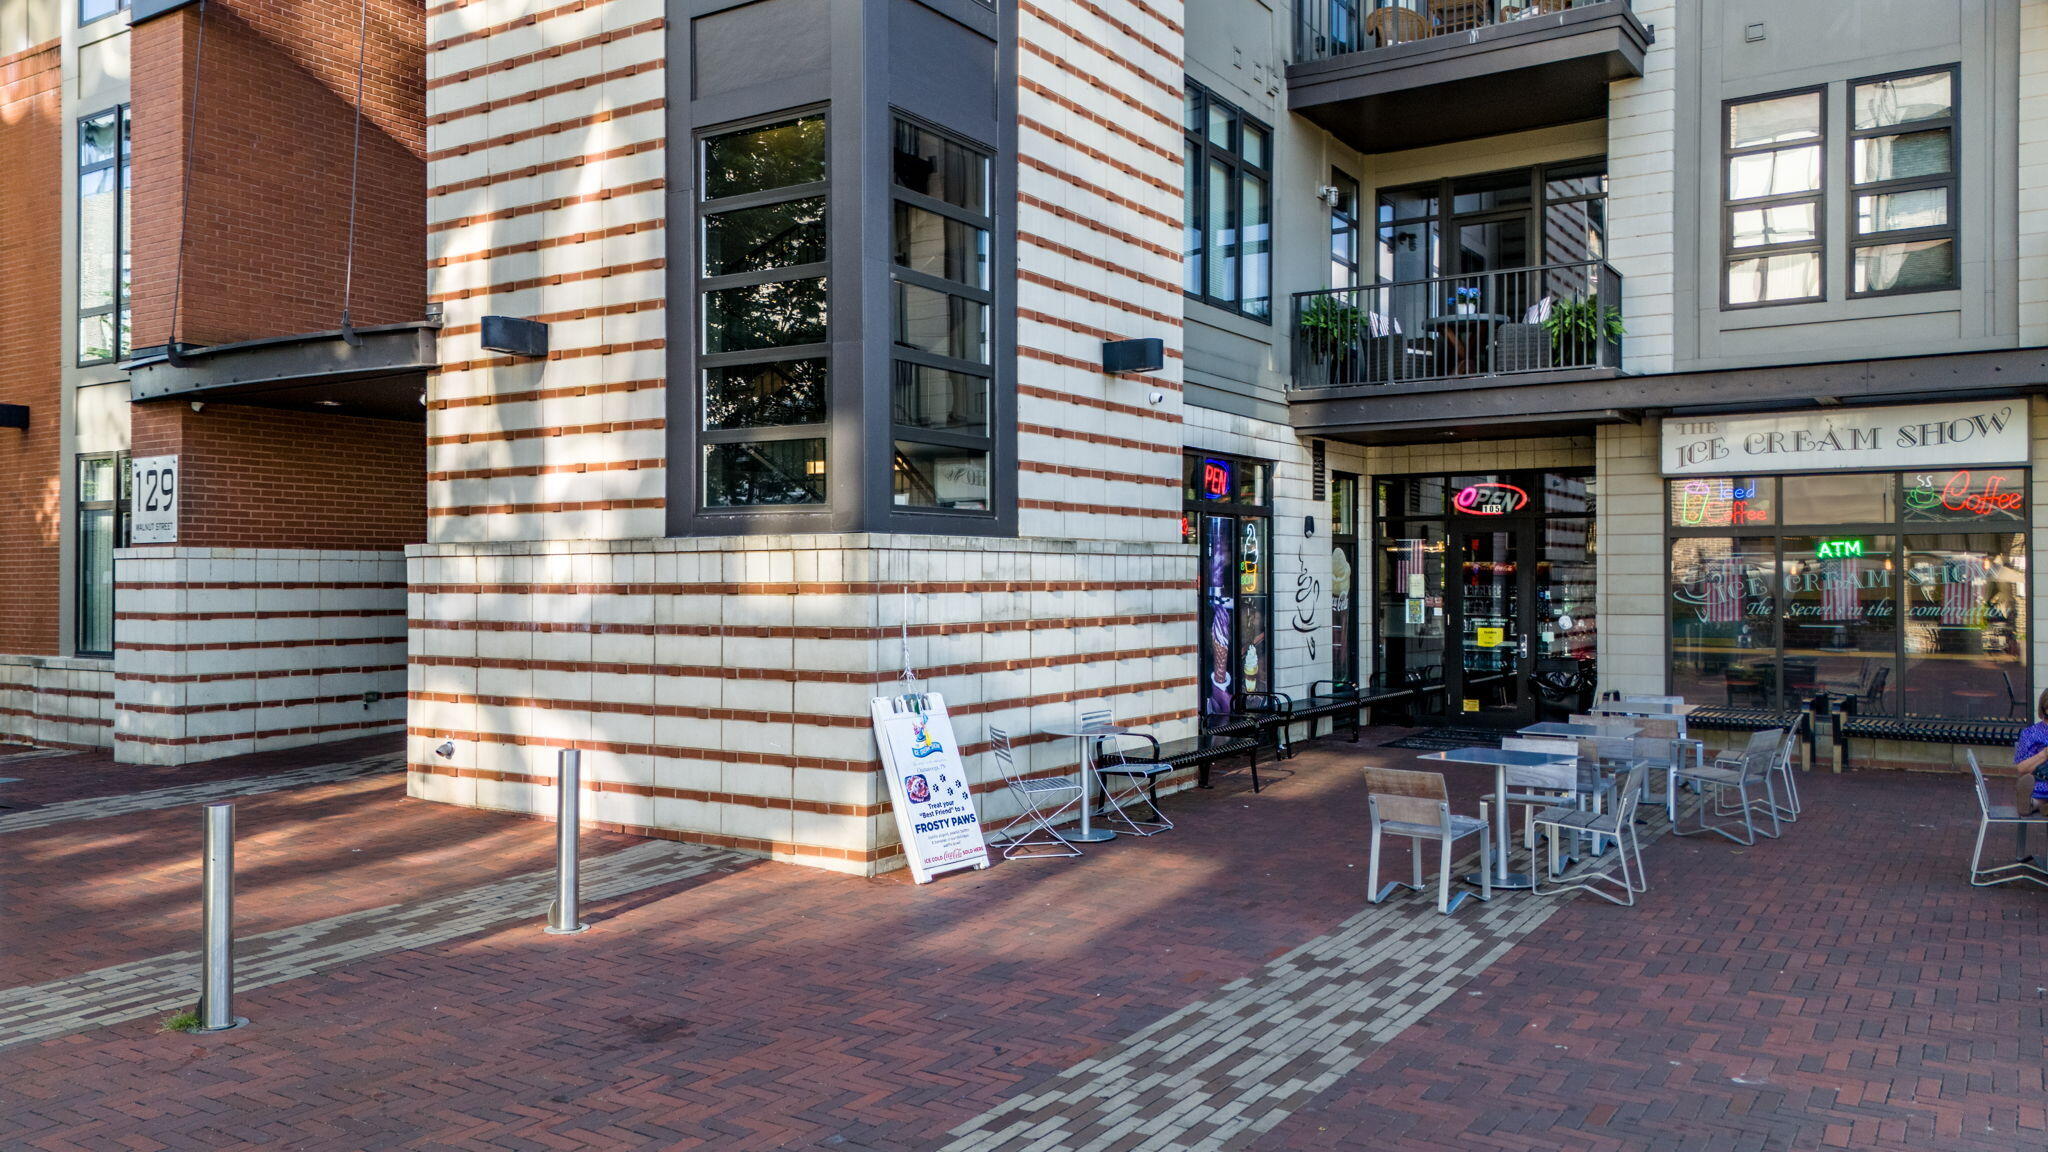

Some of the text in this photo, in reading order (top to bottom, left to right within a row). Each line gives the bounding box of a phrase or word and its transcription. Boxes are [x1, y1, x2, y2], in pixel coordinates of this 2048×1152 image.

[1675, 421, 1718, 435] THE
[1675, 406, 2012, 469] ICE CREAM SHOW
[136, 468, 174, 512] 129
[1204, 464, 1228, 496] PEN
[1719, 479, 1756, 501] Iced
[1458, 487, 1520, 512] OPEN
[1942, 470, 2023, 515] Coffee
[1704, 500, 1768, 525] Coffee
[136, 522, 173, 531] WALNUT STREET
[1817, 541, 1862, 559] ATM
[1711, 562, 2003, 602] ICE CREAM SHOW
[1746, 596, 1774, 615] The
[1848, 603, 1864, 617] in
[1867, 597, 1893, 617] the
[1908, 597, 2012, 618] combination
[928, 800, 954, 810] Treat your
[915, 818, 949, 834] FROSTY
[951, 813, 976, 827] PAWS
